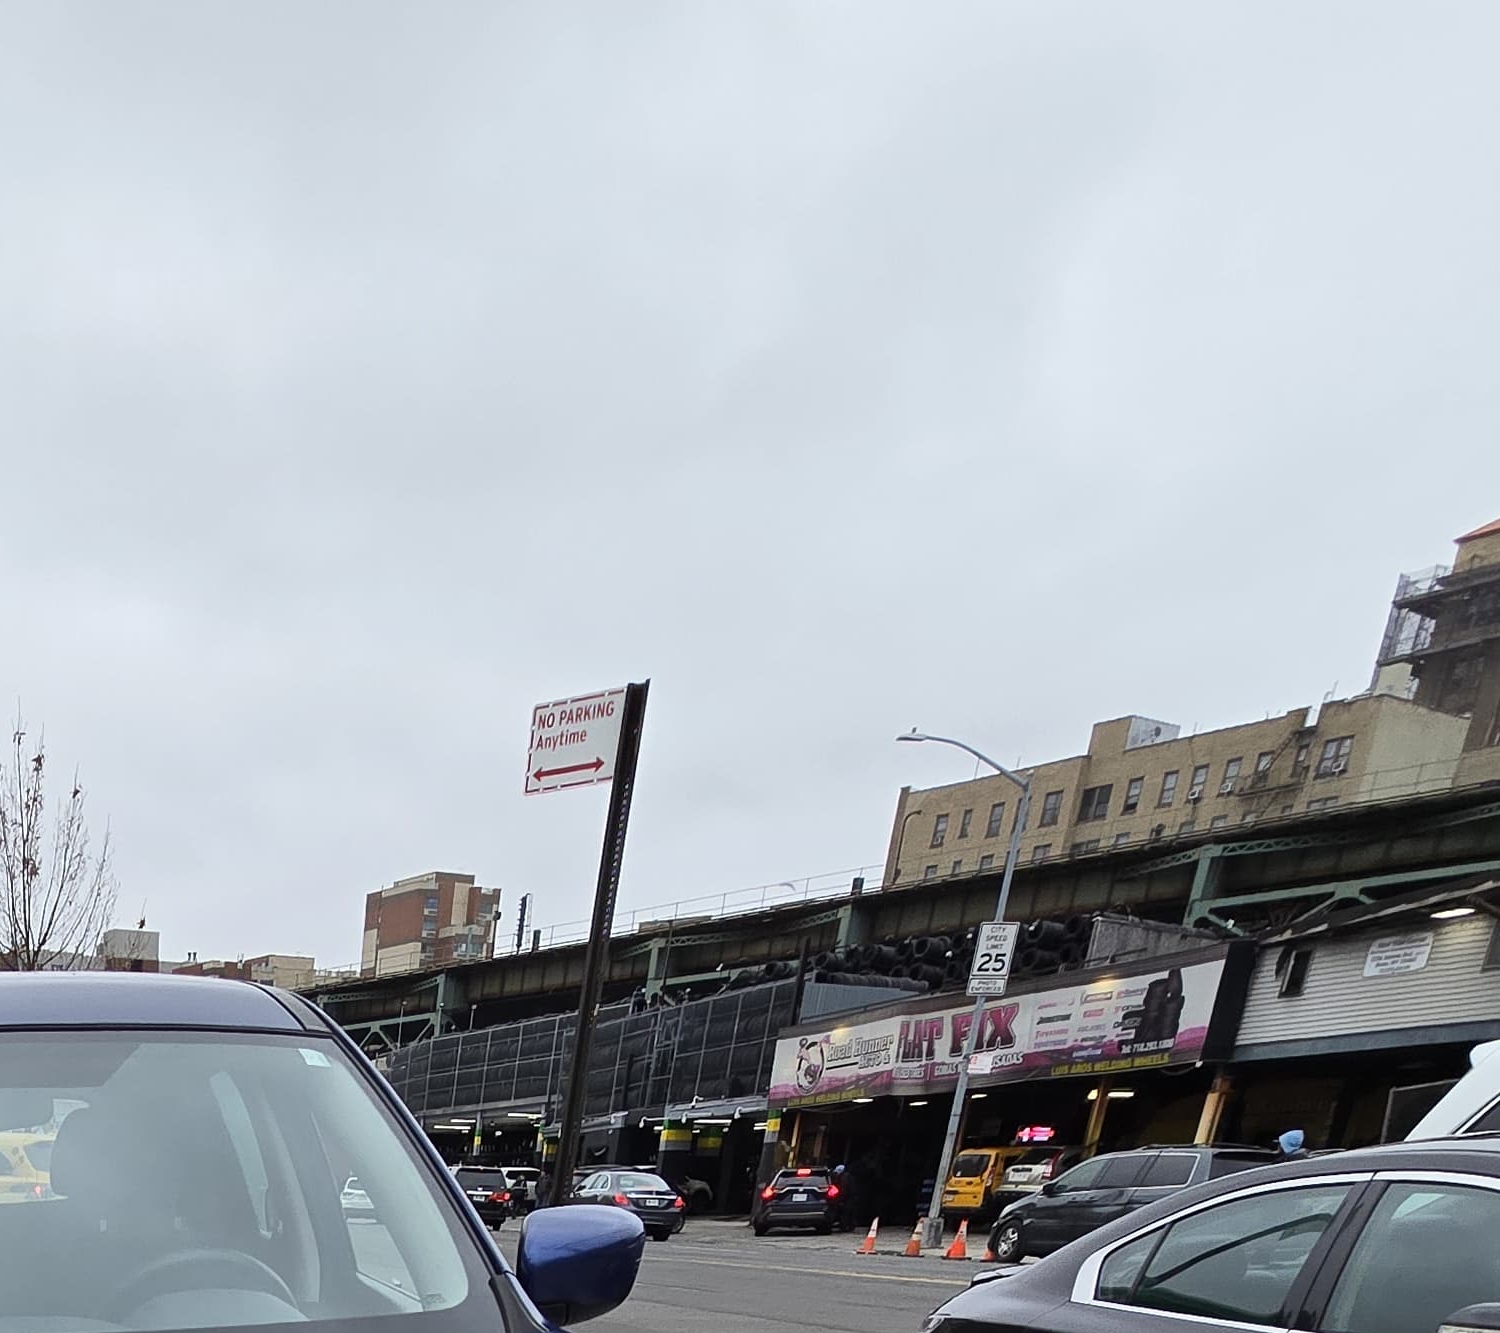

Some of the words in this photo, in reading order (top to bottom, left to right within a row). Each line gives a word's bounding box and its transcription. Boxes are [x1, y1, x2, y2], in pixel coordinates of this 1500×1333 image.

[537, 712, 555, 730] NO
[559, 701, 615, 726] PARKING
[535, 729, 588, 752] Anytime
[985, 934, 1008, 942] SPEED
[976, 952, 1007, 972] 25
